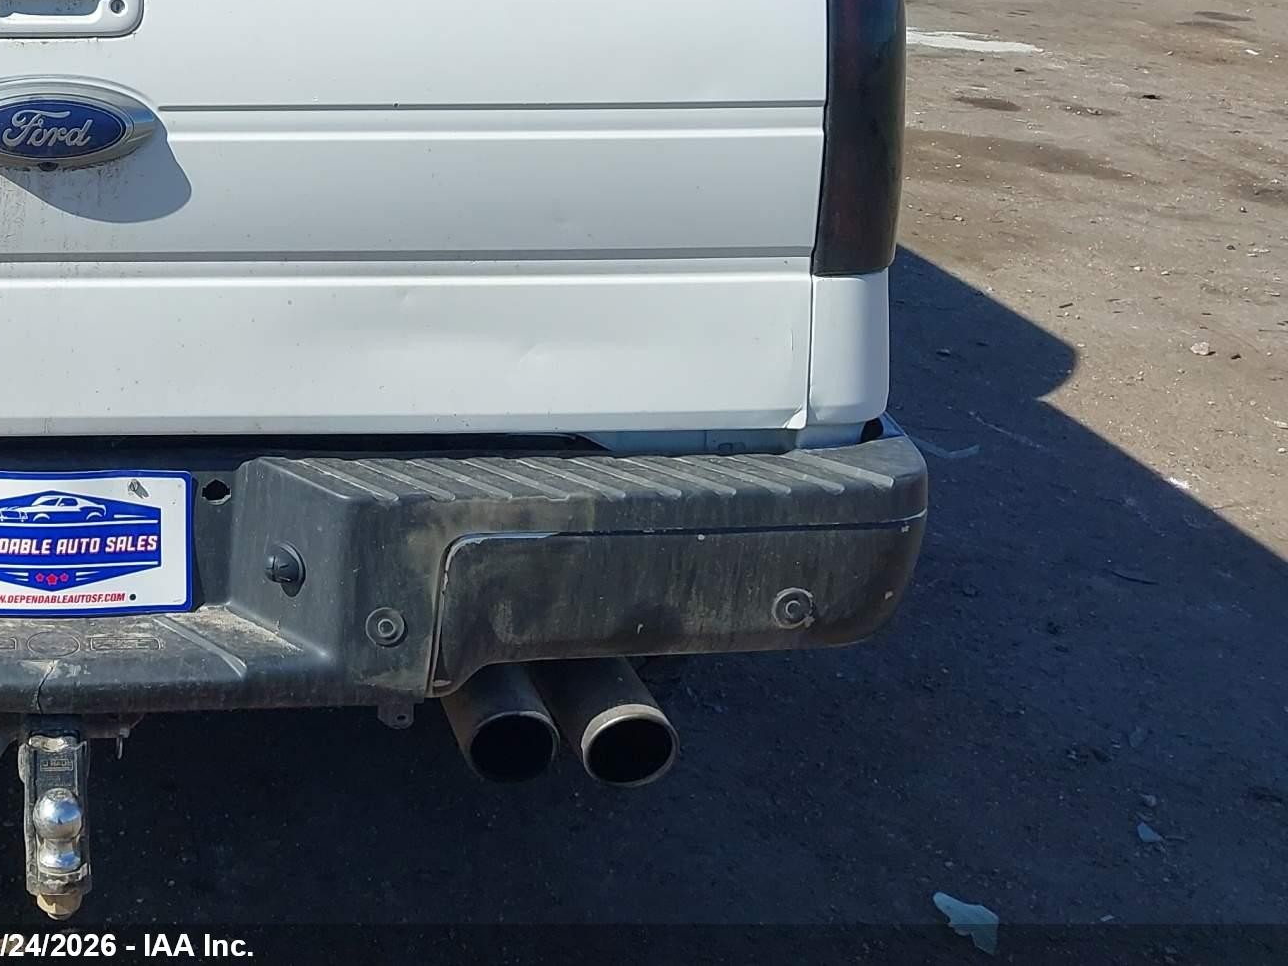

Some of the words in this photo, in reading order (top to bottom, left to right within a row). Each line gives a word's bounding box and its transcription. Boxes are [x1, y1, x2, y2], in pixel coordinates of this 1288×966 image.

[2, 109, 93, 147] Ford
[56, 537, 100, 554] AUTO
[104, 535, 159, 552] SALES
